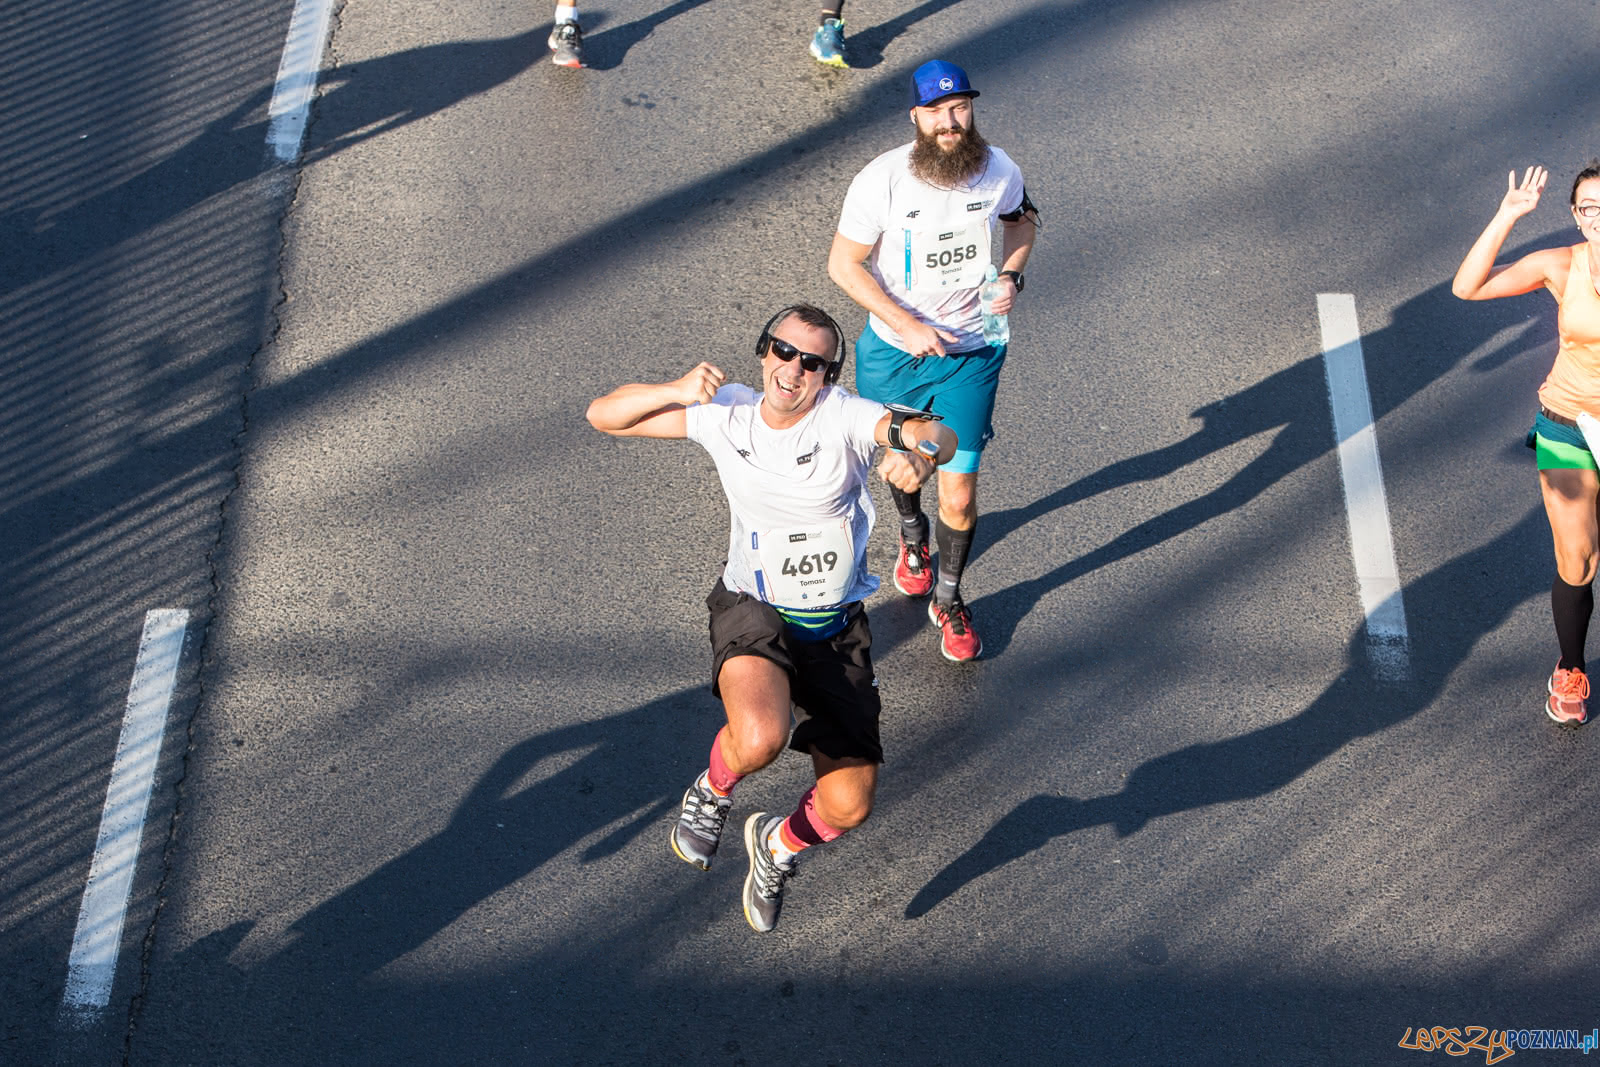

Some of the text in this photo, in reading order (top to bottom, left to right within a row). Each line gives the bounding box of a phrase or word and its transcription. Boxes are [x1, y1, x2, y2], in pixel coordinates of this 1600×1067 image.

[906, 210, 920, 218] 4F
[926, 244, 977, 268] 5058
[942, 267, 962, 275] Tomasz
[782, 551, 838, 576] 4619
[800, 579, 826, 587] Tomasz
